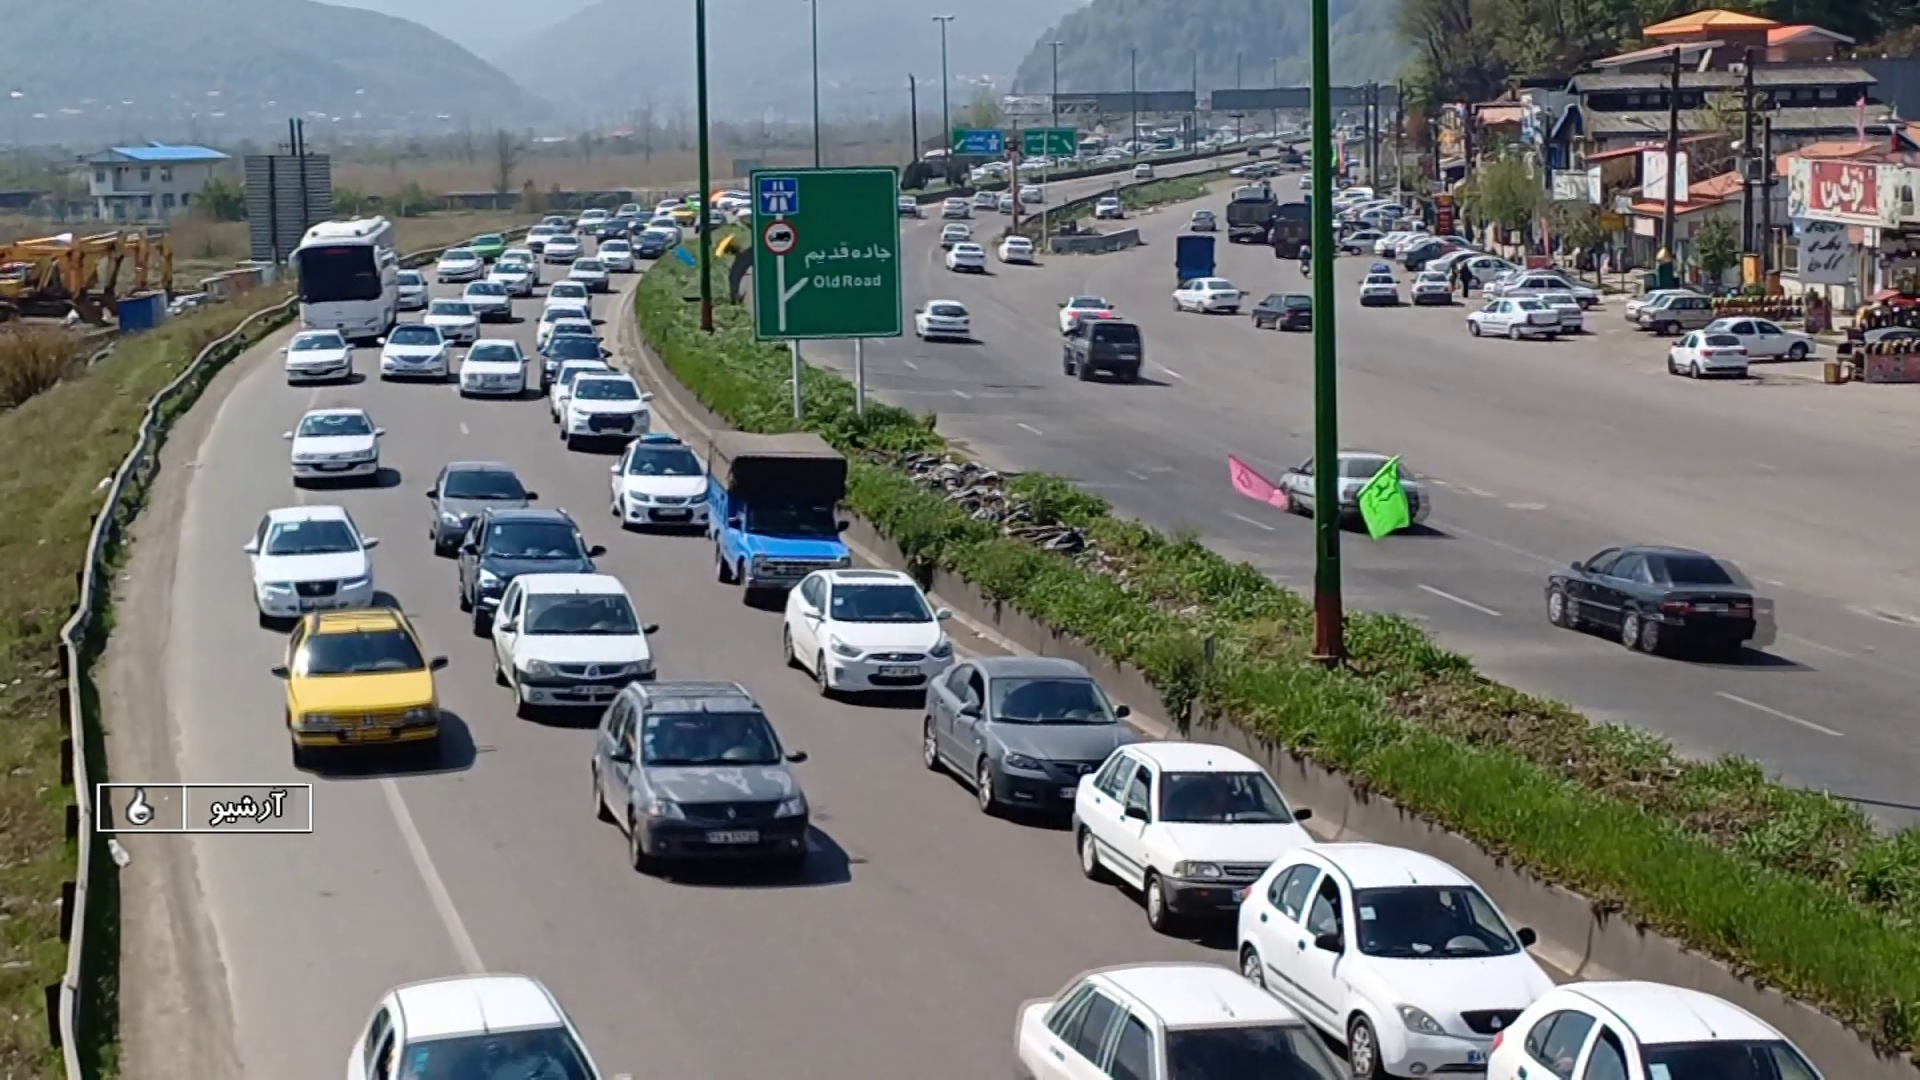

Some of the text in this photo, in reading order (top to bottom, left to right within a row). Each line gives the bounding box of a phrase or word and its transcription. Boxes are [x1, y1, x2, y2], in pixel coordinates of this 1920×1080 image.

[804, 241, 892, 268] جاده قدیم
[813, 274, 882, 288] Old Road
